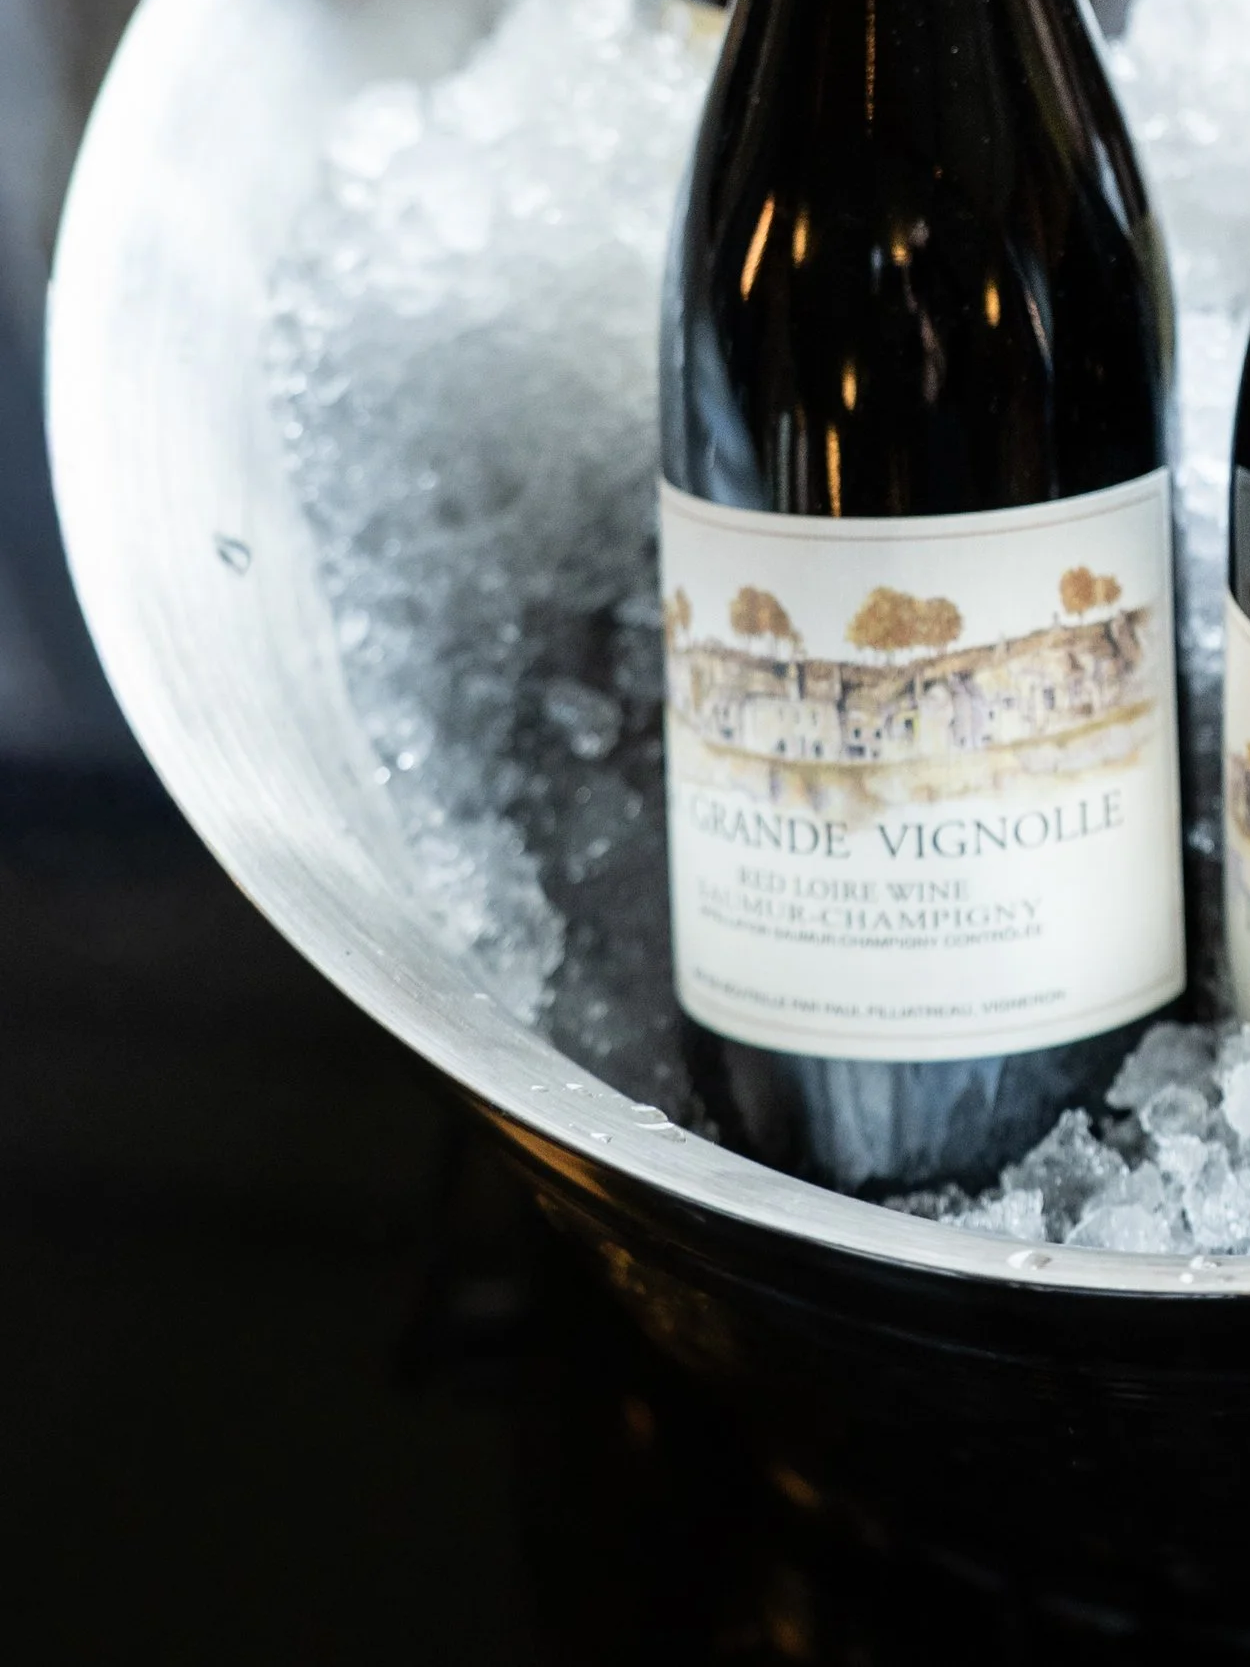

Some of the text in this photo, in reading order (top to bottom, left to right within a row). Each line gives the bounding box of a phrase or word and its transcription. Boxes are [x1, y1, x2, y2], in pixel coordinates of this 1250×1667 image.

[690, 789, 1125, 860] GRANDE VIGNOLLE
[738, 865, 969, 903] RED LOIRE WINE
